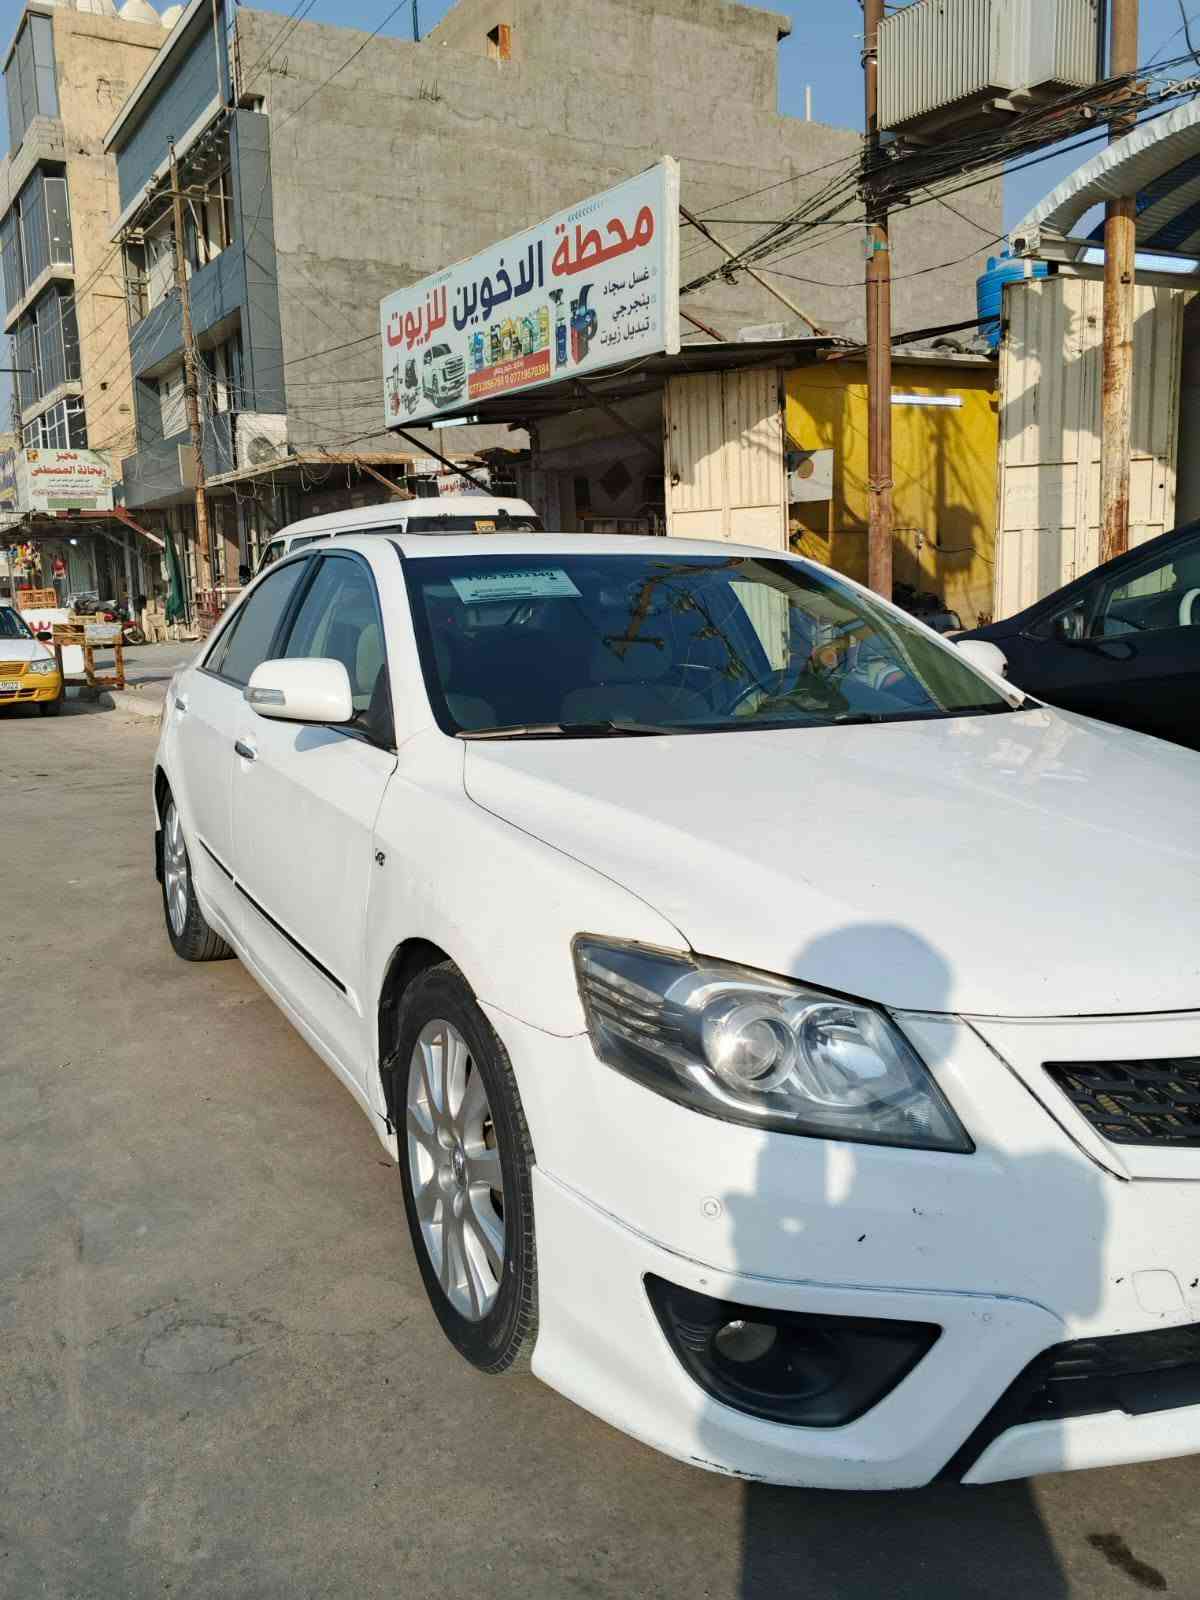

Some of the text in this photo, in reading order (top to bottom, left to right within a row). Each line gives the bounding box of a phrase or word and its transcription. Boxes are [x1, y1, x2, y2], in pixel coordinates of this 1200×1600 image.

[386, 205, 656, 352] محطة الاخوين للزيوت
[603, 267, 650, 297] غسل سجاد
[612, 293, 650, 321] بنجرجي
[600, 316, 650, 346] تبديل زيوت
